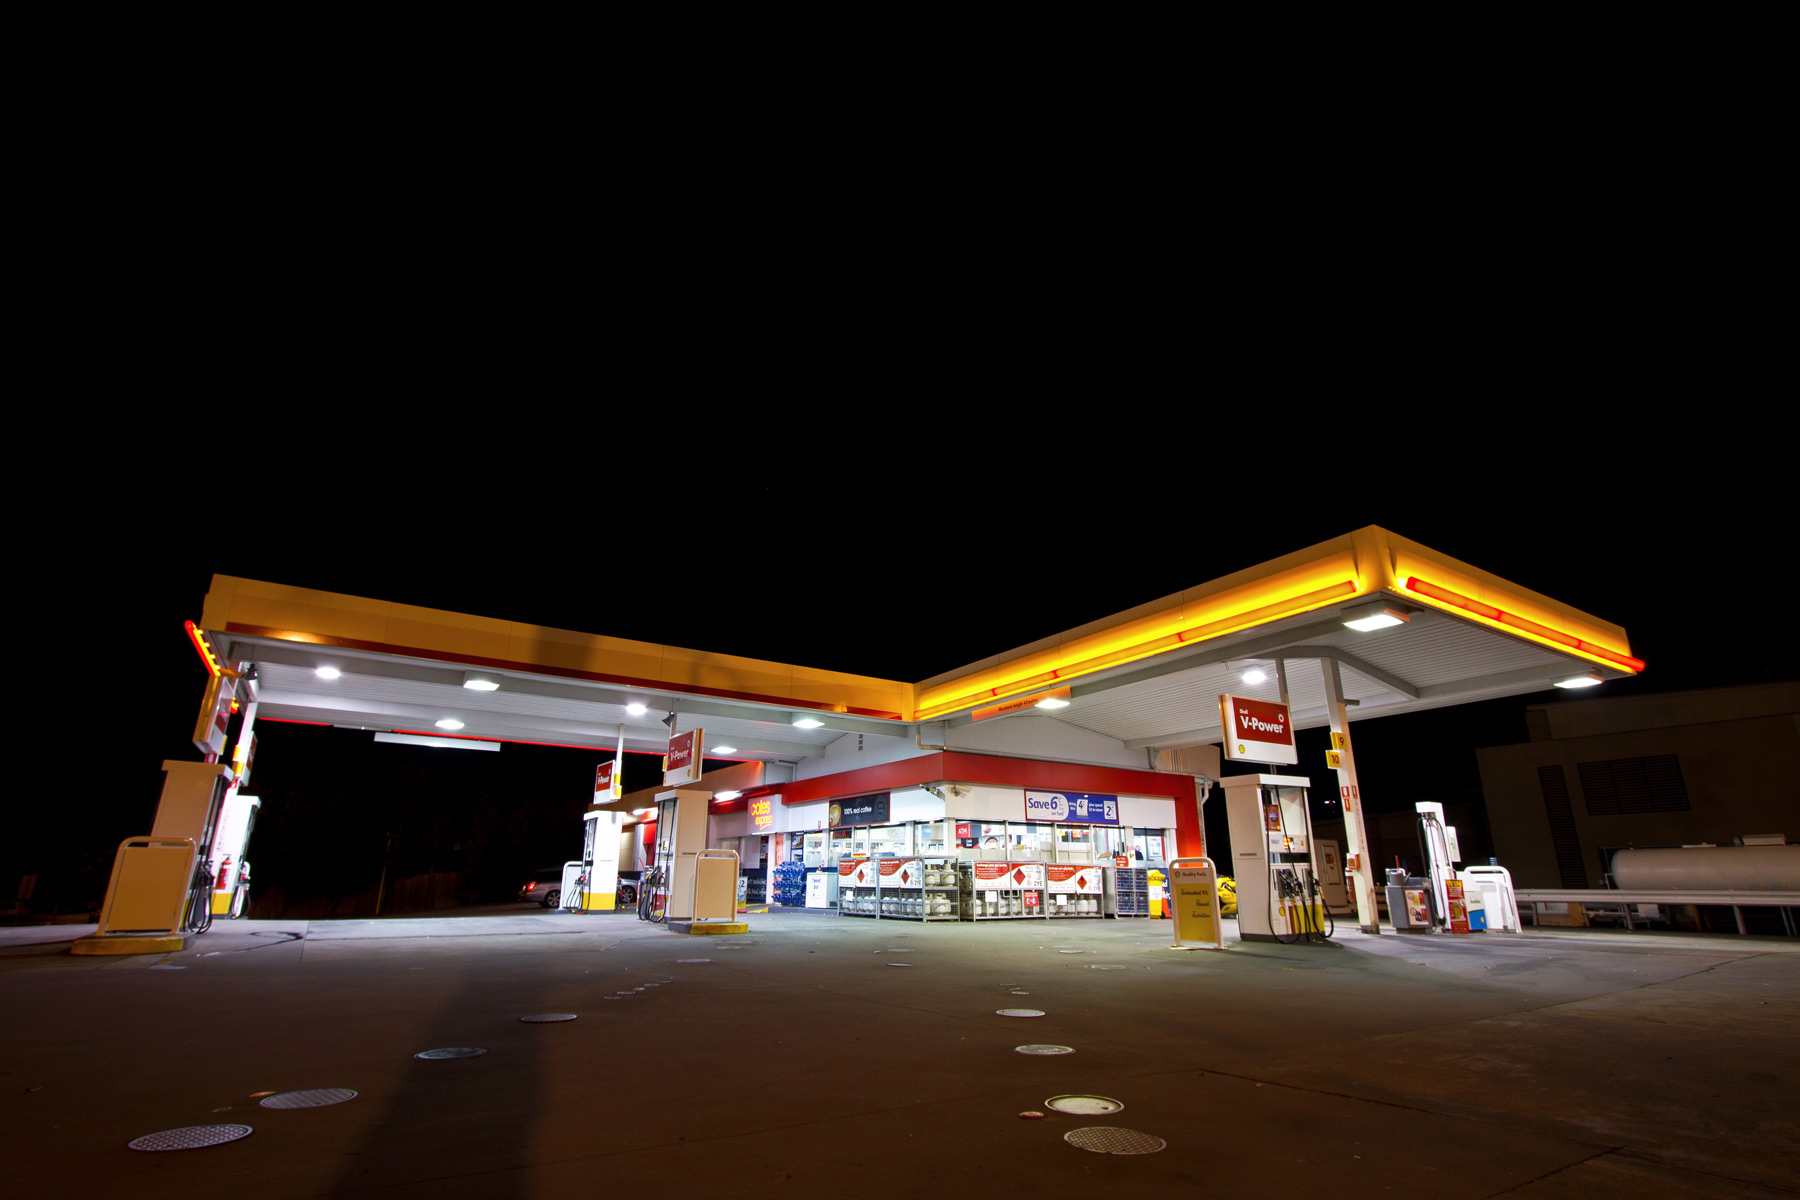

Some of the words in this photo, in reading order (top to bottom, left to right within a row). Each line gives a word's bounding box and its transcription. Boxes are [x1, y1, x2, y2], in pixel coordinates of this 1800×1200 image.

[1240, 716, 1284, 734] V-Power
[1340, 736, 1345, 746] 9
[670, 750, 689, 762] V-Power
[1331, 754, 1340, 764] 10
[598, 776, 609, 785] V-Power
[750, 800, 770, 816] coles
[1028, 798, 1049, 809] Save
